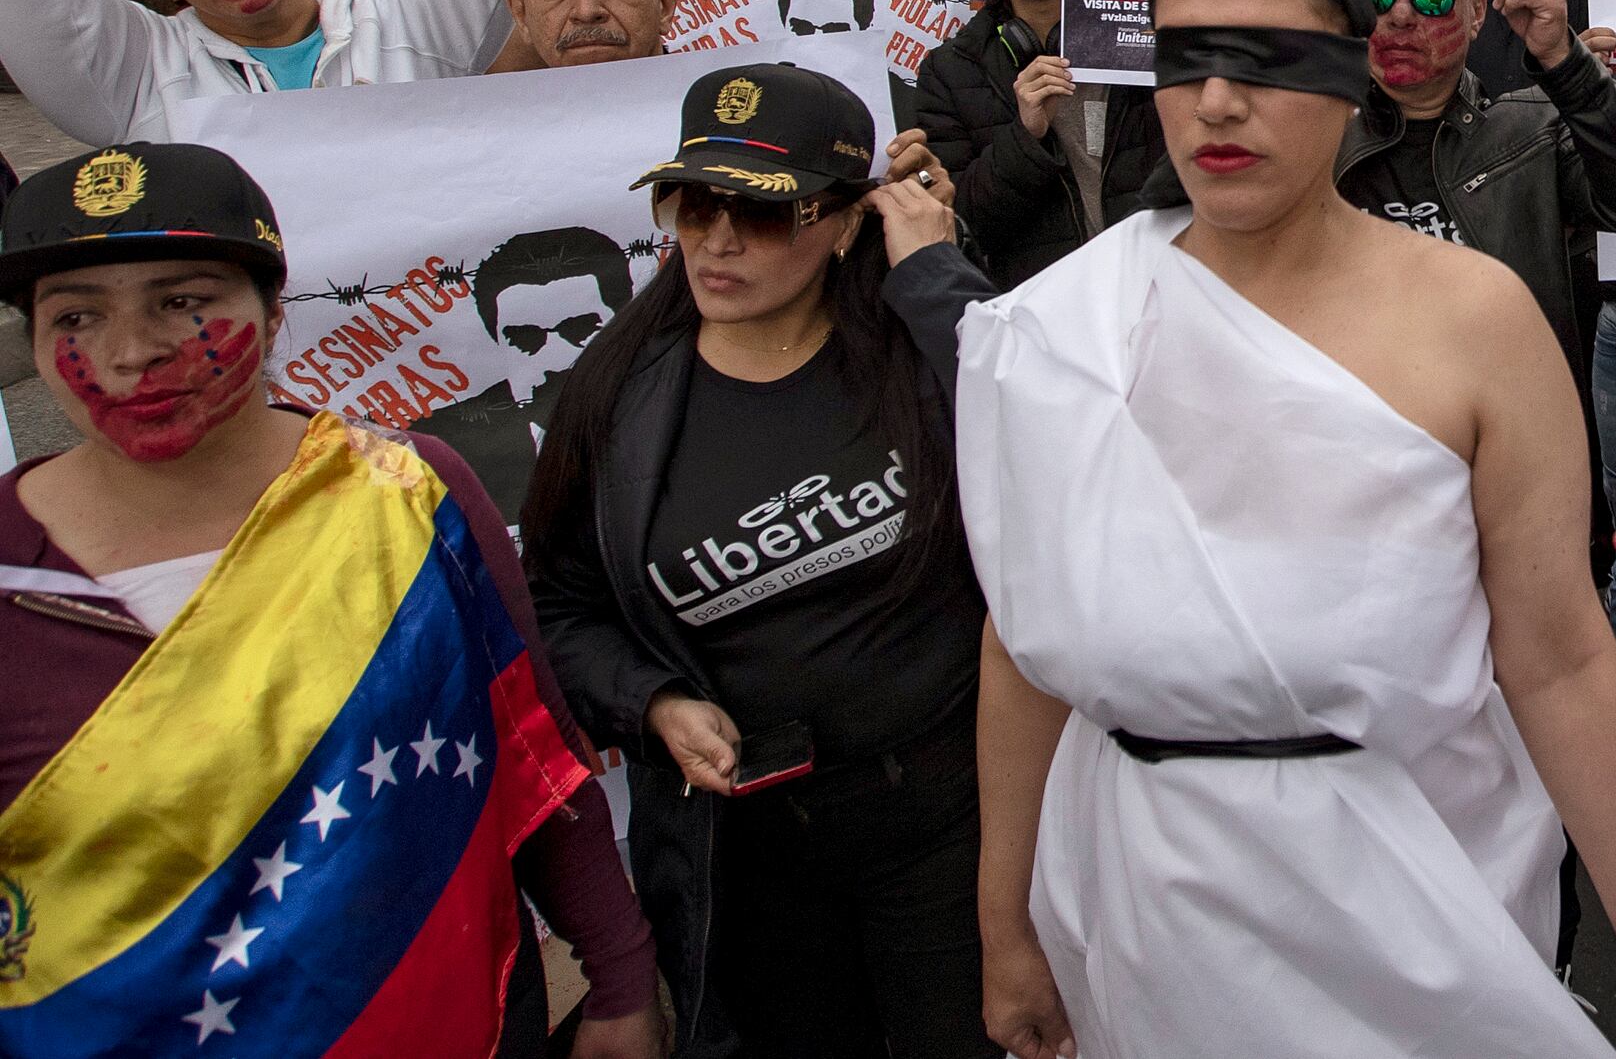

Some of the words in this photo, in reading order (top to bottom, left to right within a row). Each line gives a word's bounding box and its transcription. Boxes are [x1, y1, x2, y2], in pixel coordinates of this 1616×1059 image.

[1083, 0, 1121, 10] VISITA
[1123, 1, 1139, 11] DE
[648, 449, 907, 608] Libertad
[693, 595, 742, 621] para
[741, 577, 777, 599] los
[780, 544, 856, 587] presos
[859, 514, 907, 555] polít
